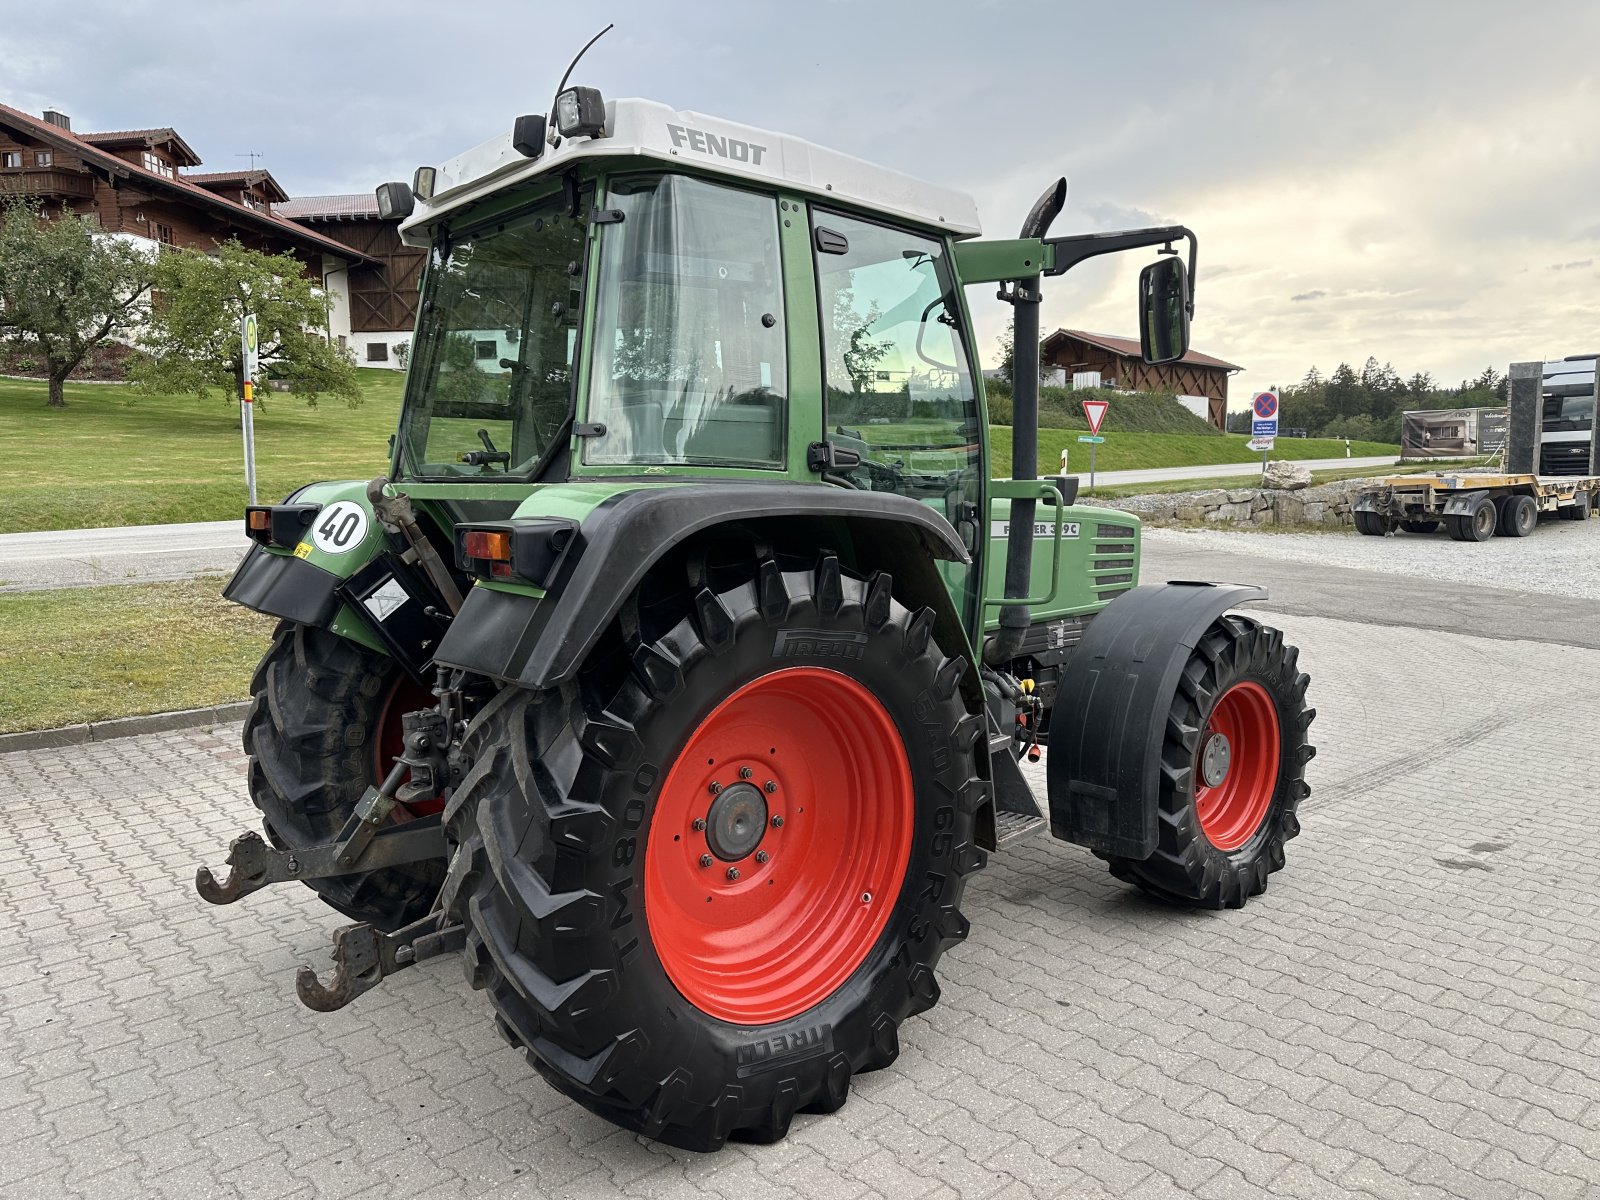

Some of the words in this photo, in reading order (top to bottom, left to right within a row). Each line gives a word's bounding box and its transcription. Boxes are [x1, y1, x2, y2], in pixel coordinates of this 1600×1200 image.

[666, 123, 767, 166] FENDT
[318, 506, 360, 547] 40
[1003, 524, 1047, 535] FER
[771, 629, 868, 661] PIRELLI
[735, 1022, 834, 1080] PIRELLI
